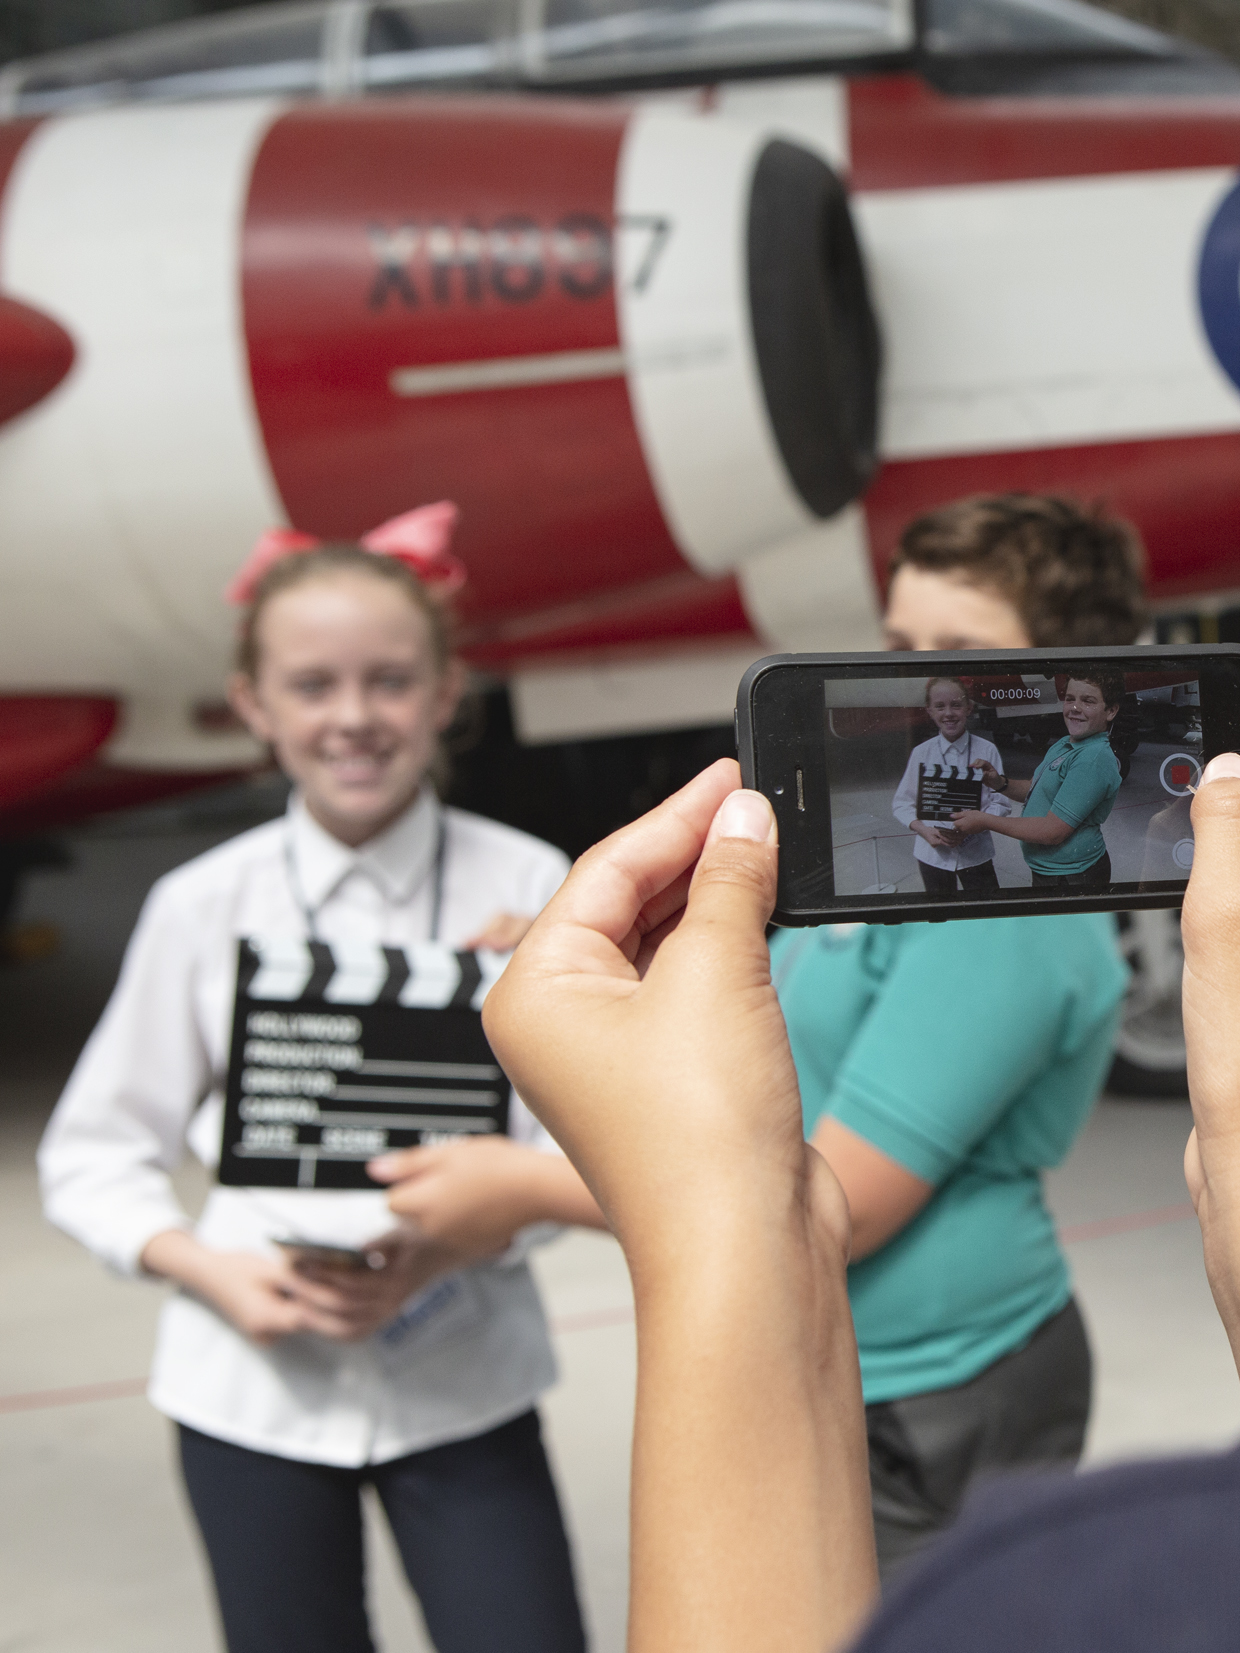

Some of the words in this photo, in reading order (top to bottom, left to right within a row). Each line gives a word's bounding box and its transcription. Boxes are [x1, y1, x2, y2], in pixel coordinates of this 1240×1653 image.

[367, 211, 674, 313] XH897
[990, 688, 1041, 700] 00:00:09
[247, 1012, 362, 1042] HOLLYWOOD
[244, 1040, 363, 1071] PRODUCTION
[241, 1068, 337, 1097] DIRECTOR
[239, 1096, 320, 1123] CAMERA
[242, 1124, 298, 1149] DATE
[321, 1128, 389, 1153] SCENE
